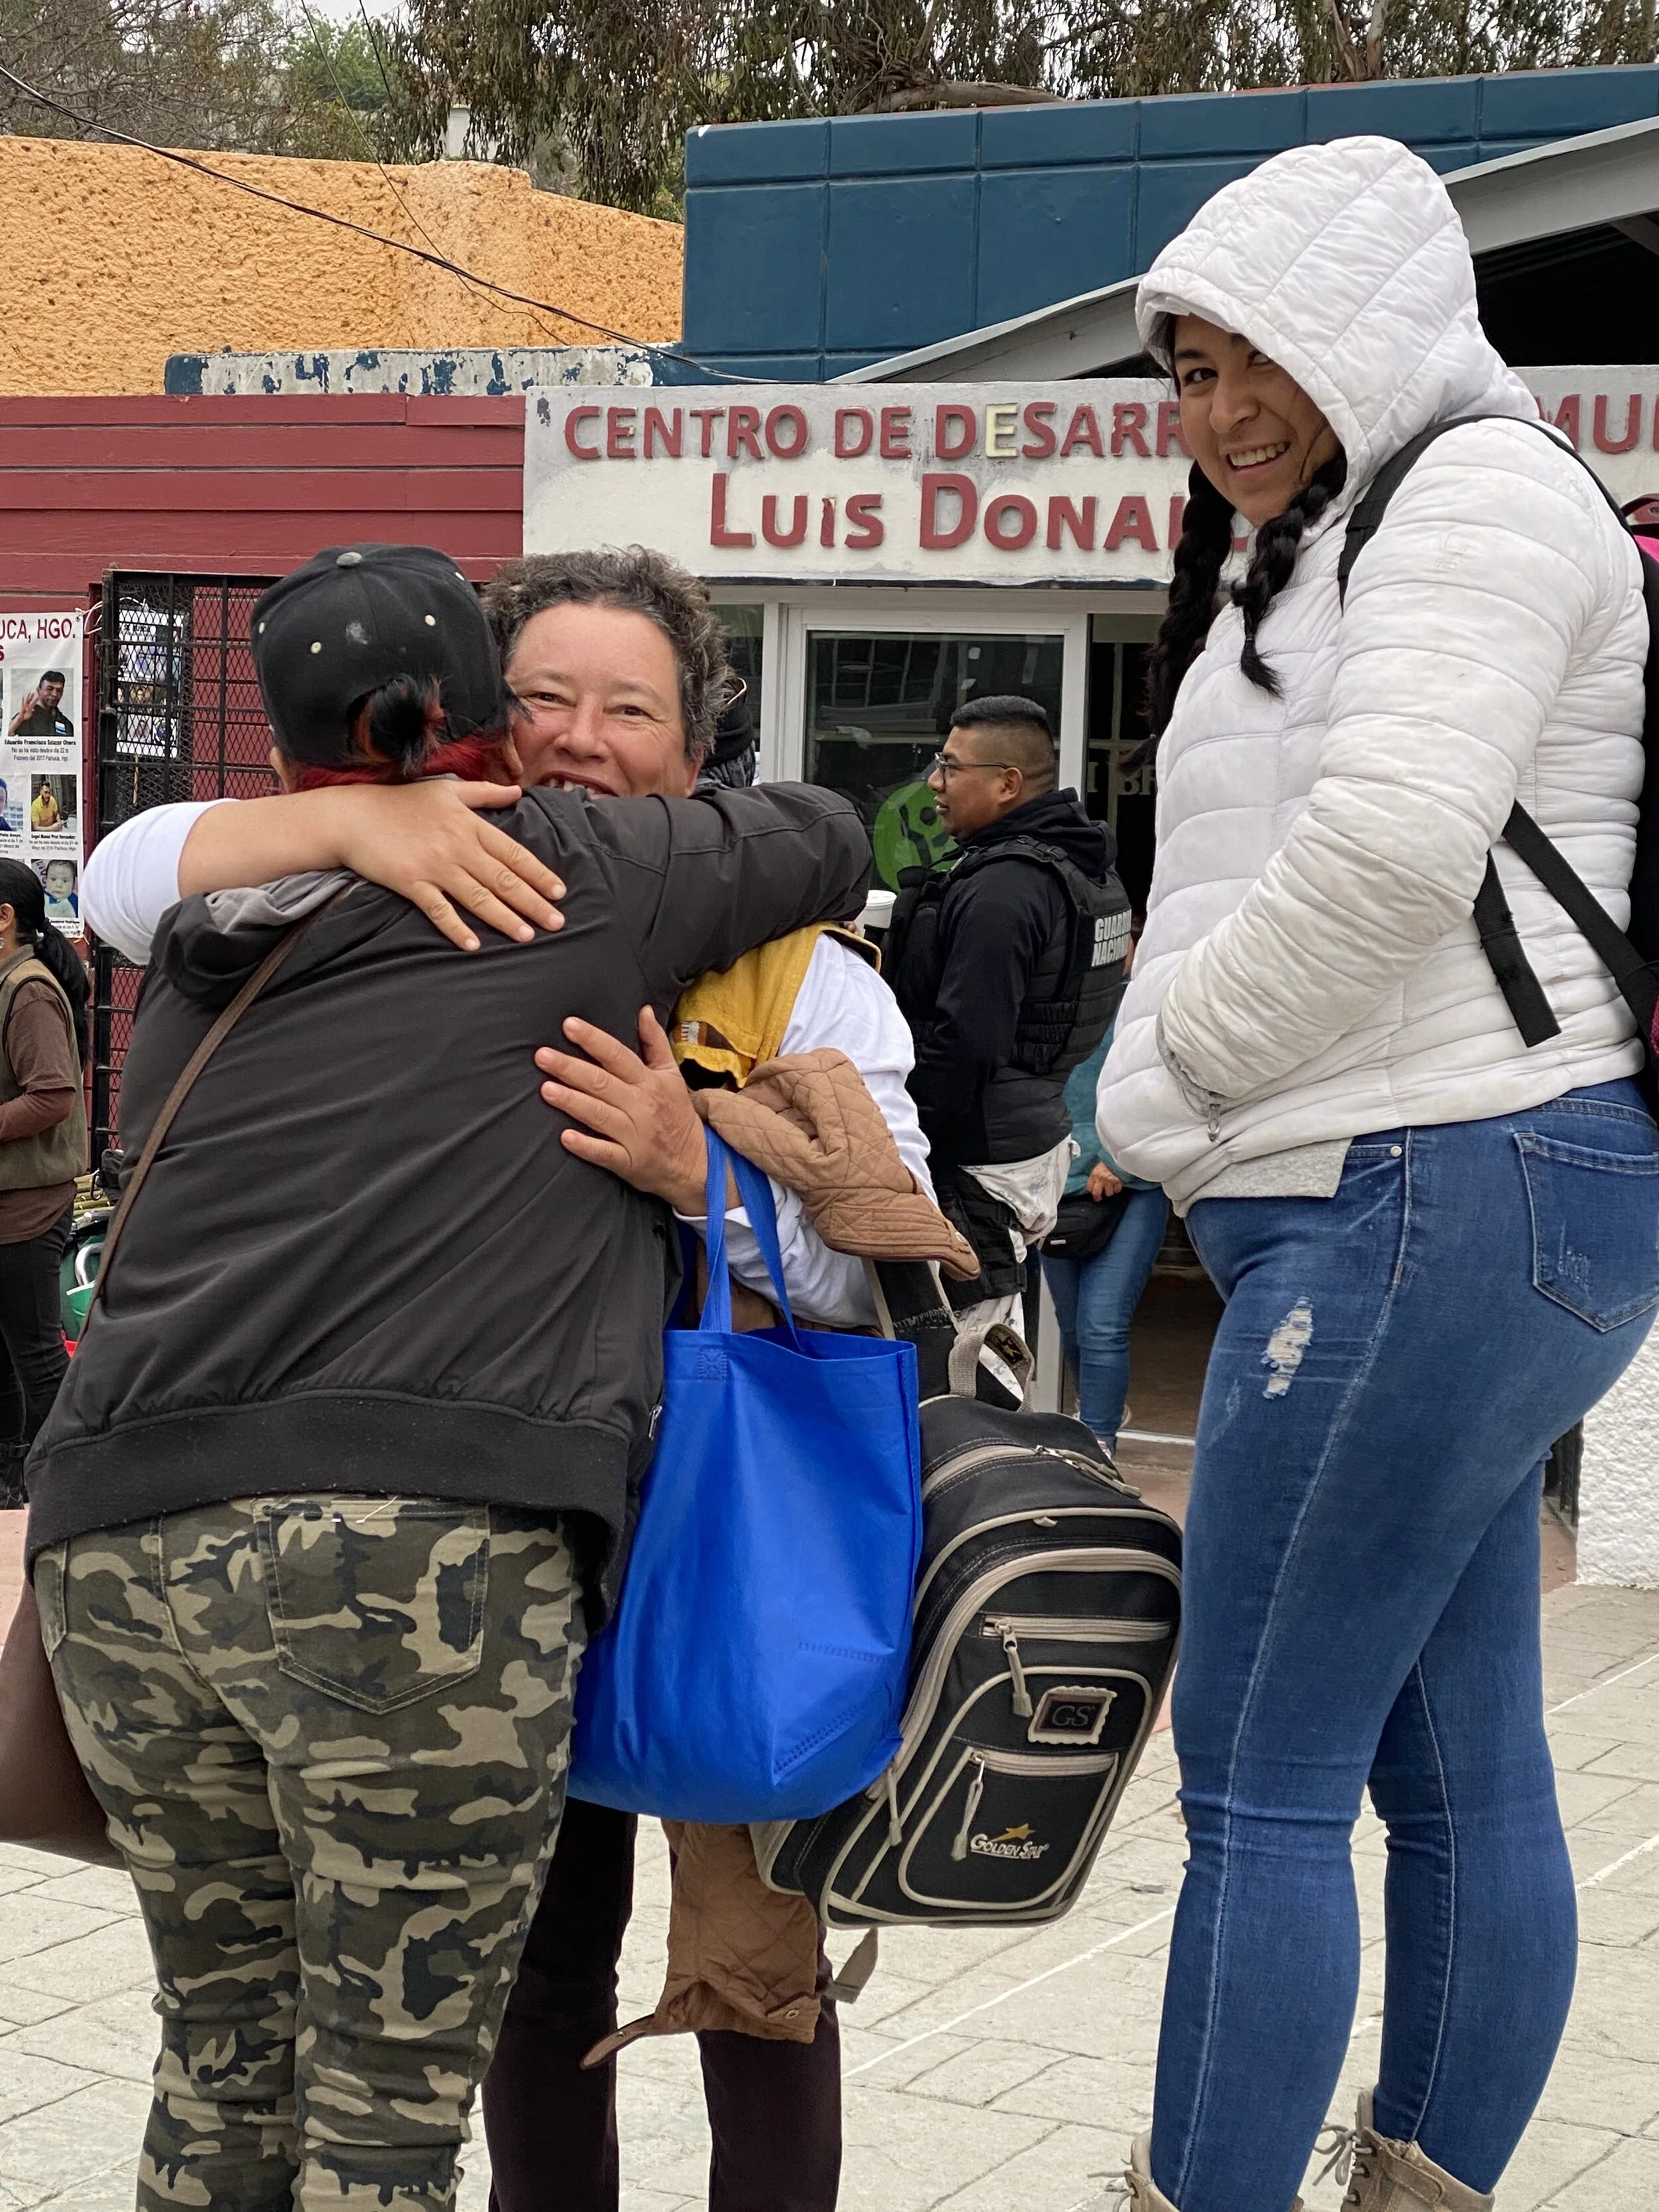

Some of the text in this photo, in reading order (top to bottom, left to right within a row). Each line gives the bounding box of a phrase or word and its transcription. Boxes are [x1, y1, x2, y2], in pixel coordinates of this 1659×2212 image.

[565, 404, 810, 460] CENTRO
[835, 406, 912, 459] DE
[710, 473, 884, 550] LUIS
[37, 618, 76, 639] HGO.
[1052, 1705, 1092, 1727] GS
[971, 1834, 1021, 1856] GOLDEN
